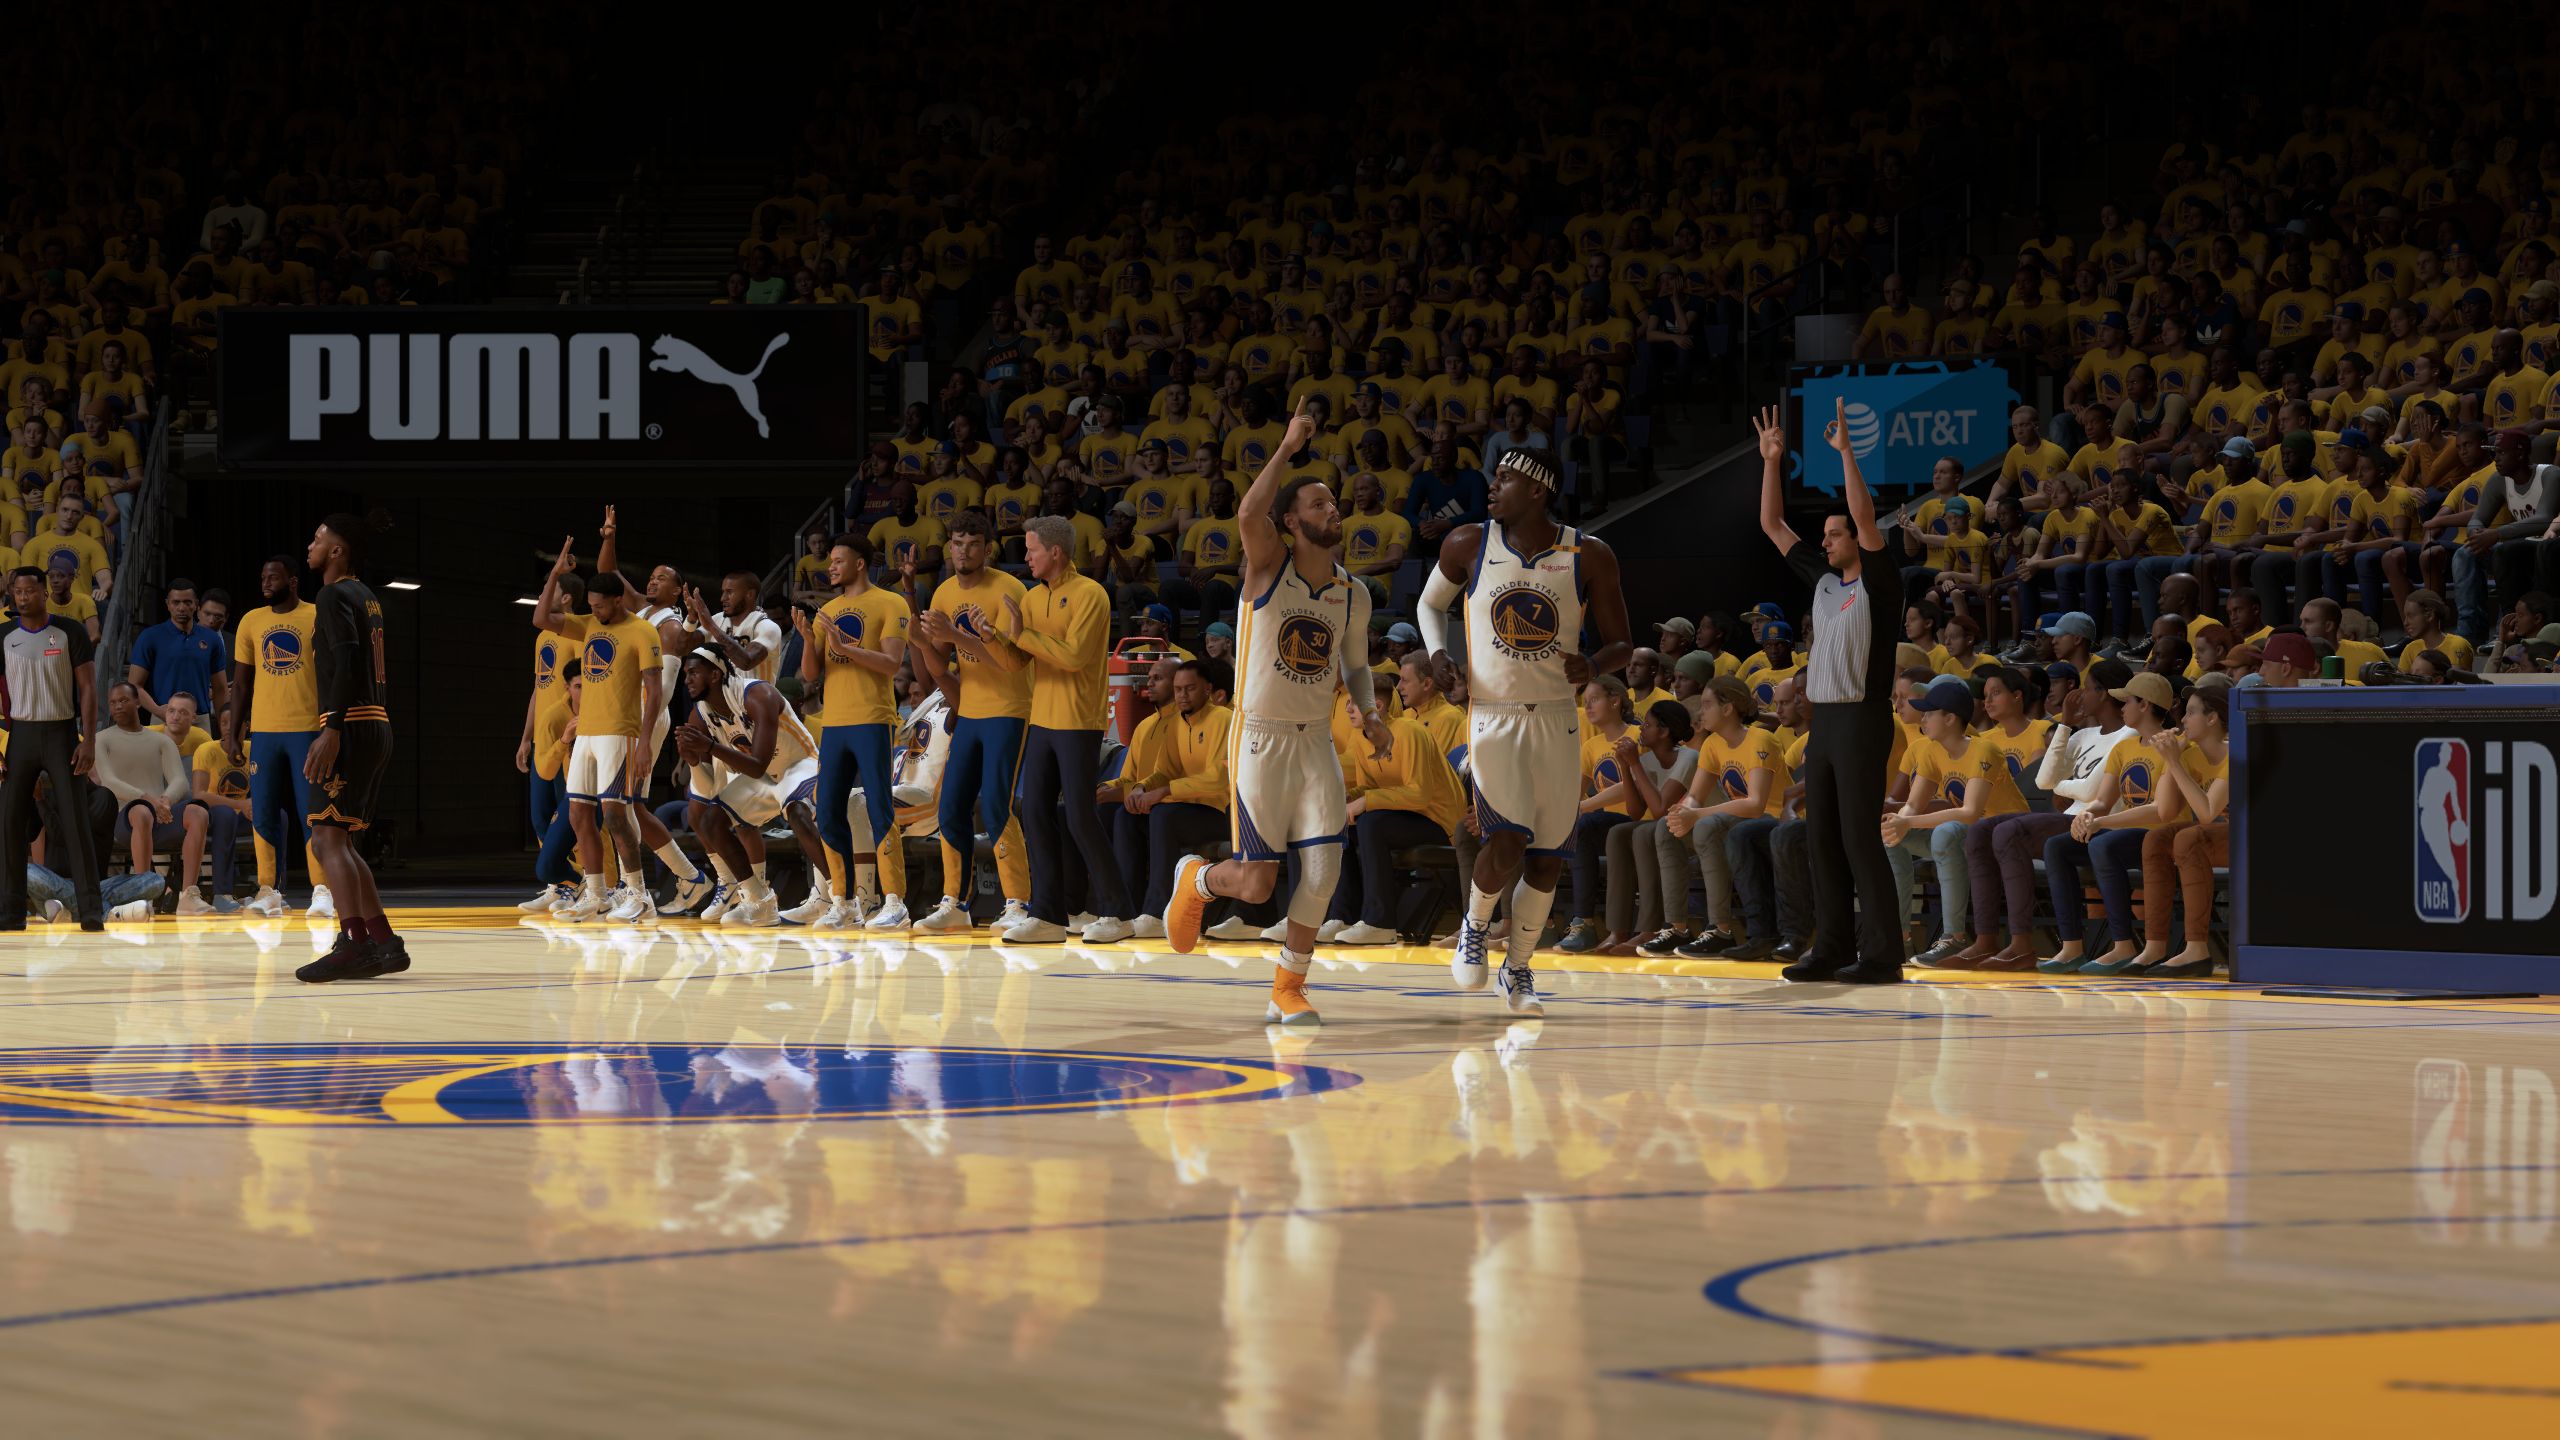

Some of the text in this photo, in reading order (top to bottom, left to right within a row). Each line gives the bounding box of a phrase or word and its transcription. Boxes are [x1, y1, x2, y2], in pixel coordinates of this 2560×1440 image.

[289, 333, 640, 440] PUMA
[1887, 409, 1977, 447] AT&T
[1490, 580, 1561, 603] GOLDEN STATE
[1281, 607, 1315, 618] GOLDEN
[1532, 603, 1543, 621] 7
[1310, 631, 1328, 647] 30
[1491, 636, 1562, 662] WARRIORS
[262, 660, 305, 677] WARRIORS
[2484, 740, 2559, 921] iD
[2423, 880, 2449, 910] NBA
